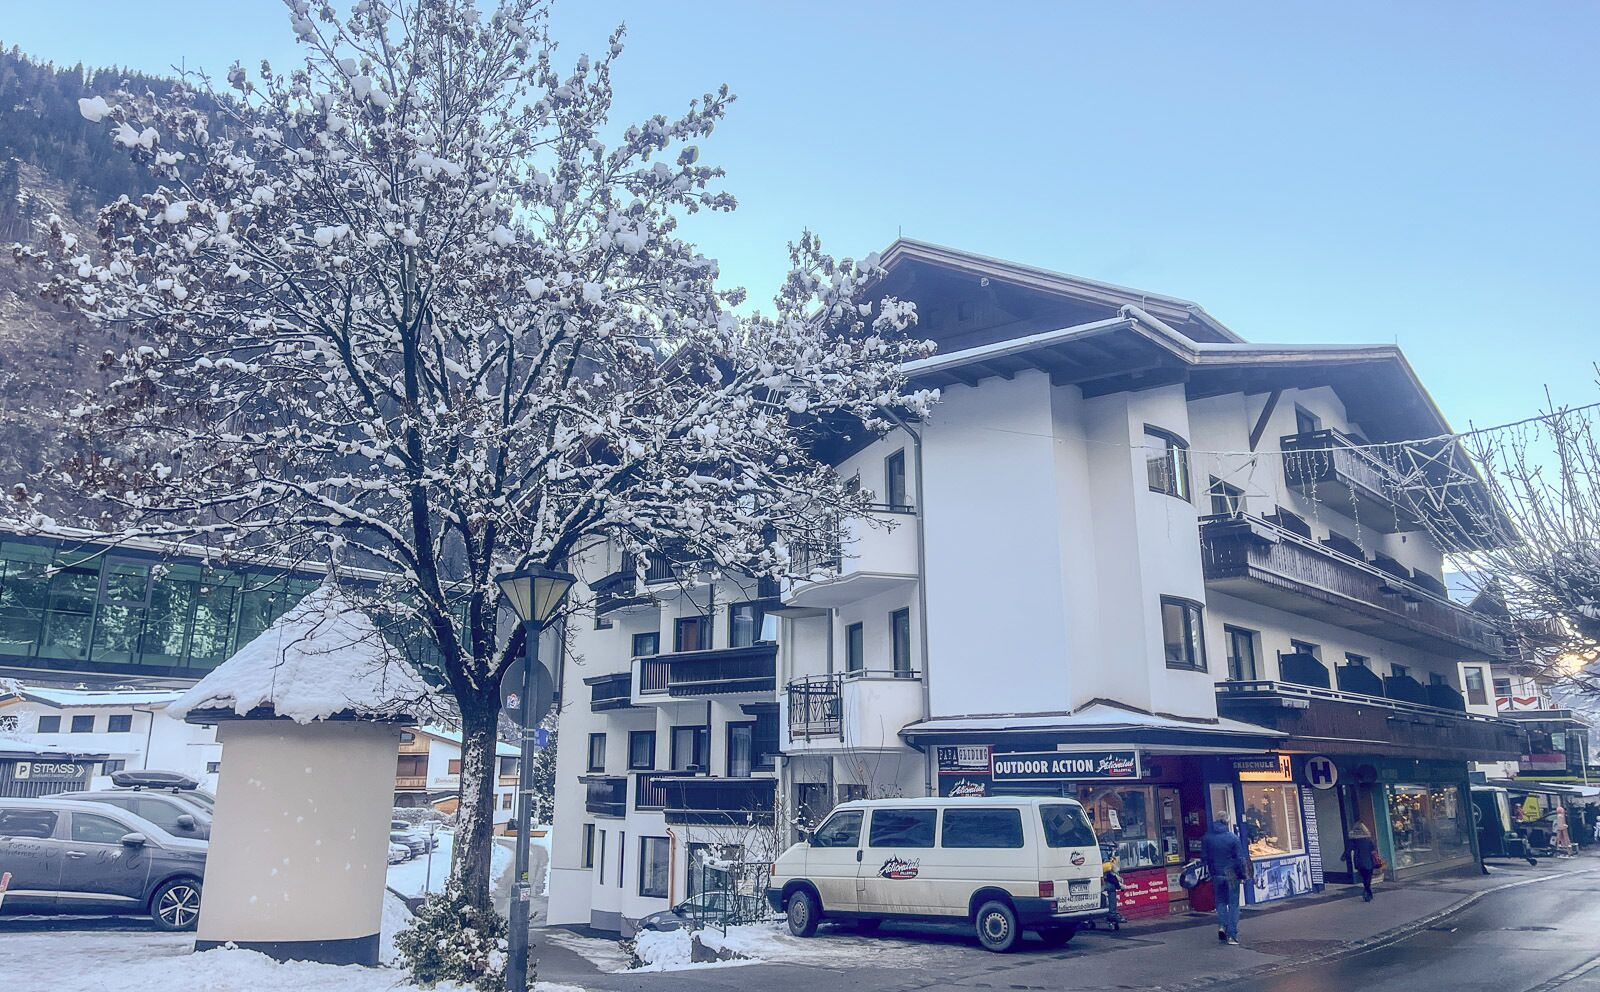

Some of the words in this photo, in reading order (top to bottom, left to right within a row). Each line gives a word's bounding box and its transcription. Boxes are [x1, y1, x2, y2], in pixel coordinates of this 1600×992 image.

[959, 748, 988, 760] GLIDING
[33, 763, 75, 774] STRASS
[995, 760, 1049, 774] OUTDOOR
[1052, 759, 1094, 773] ACTION
[1232, 761, 1275, 769] SKISCHULE
[1310, 761, 1333, 784] H
